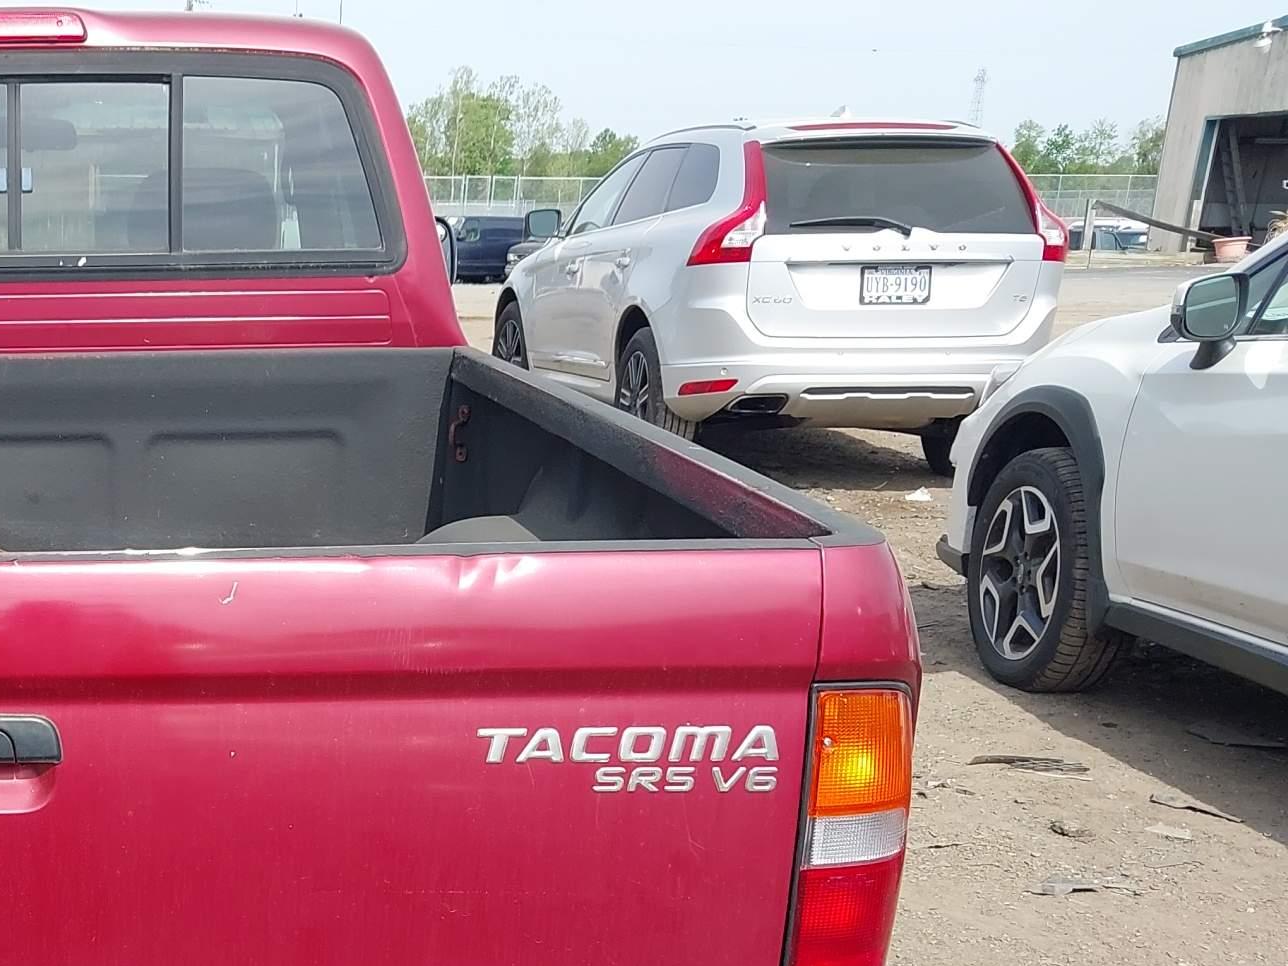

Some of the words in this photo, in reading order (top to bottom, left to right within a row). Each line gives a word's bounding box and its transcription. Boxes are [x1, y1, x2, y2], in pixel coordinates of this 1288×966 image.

[866, 276, 927, 293] UYB-9190
[864, 295, 926, 303] RALEY
[476, 724, 779, 763] TACOMA
[592, 766, 695, 793] SR5
[712, 766, 778, 793] V6
